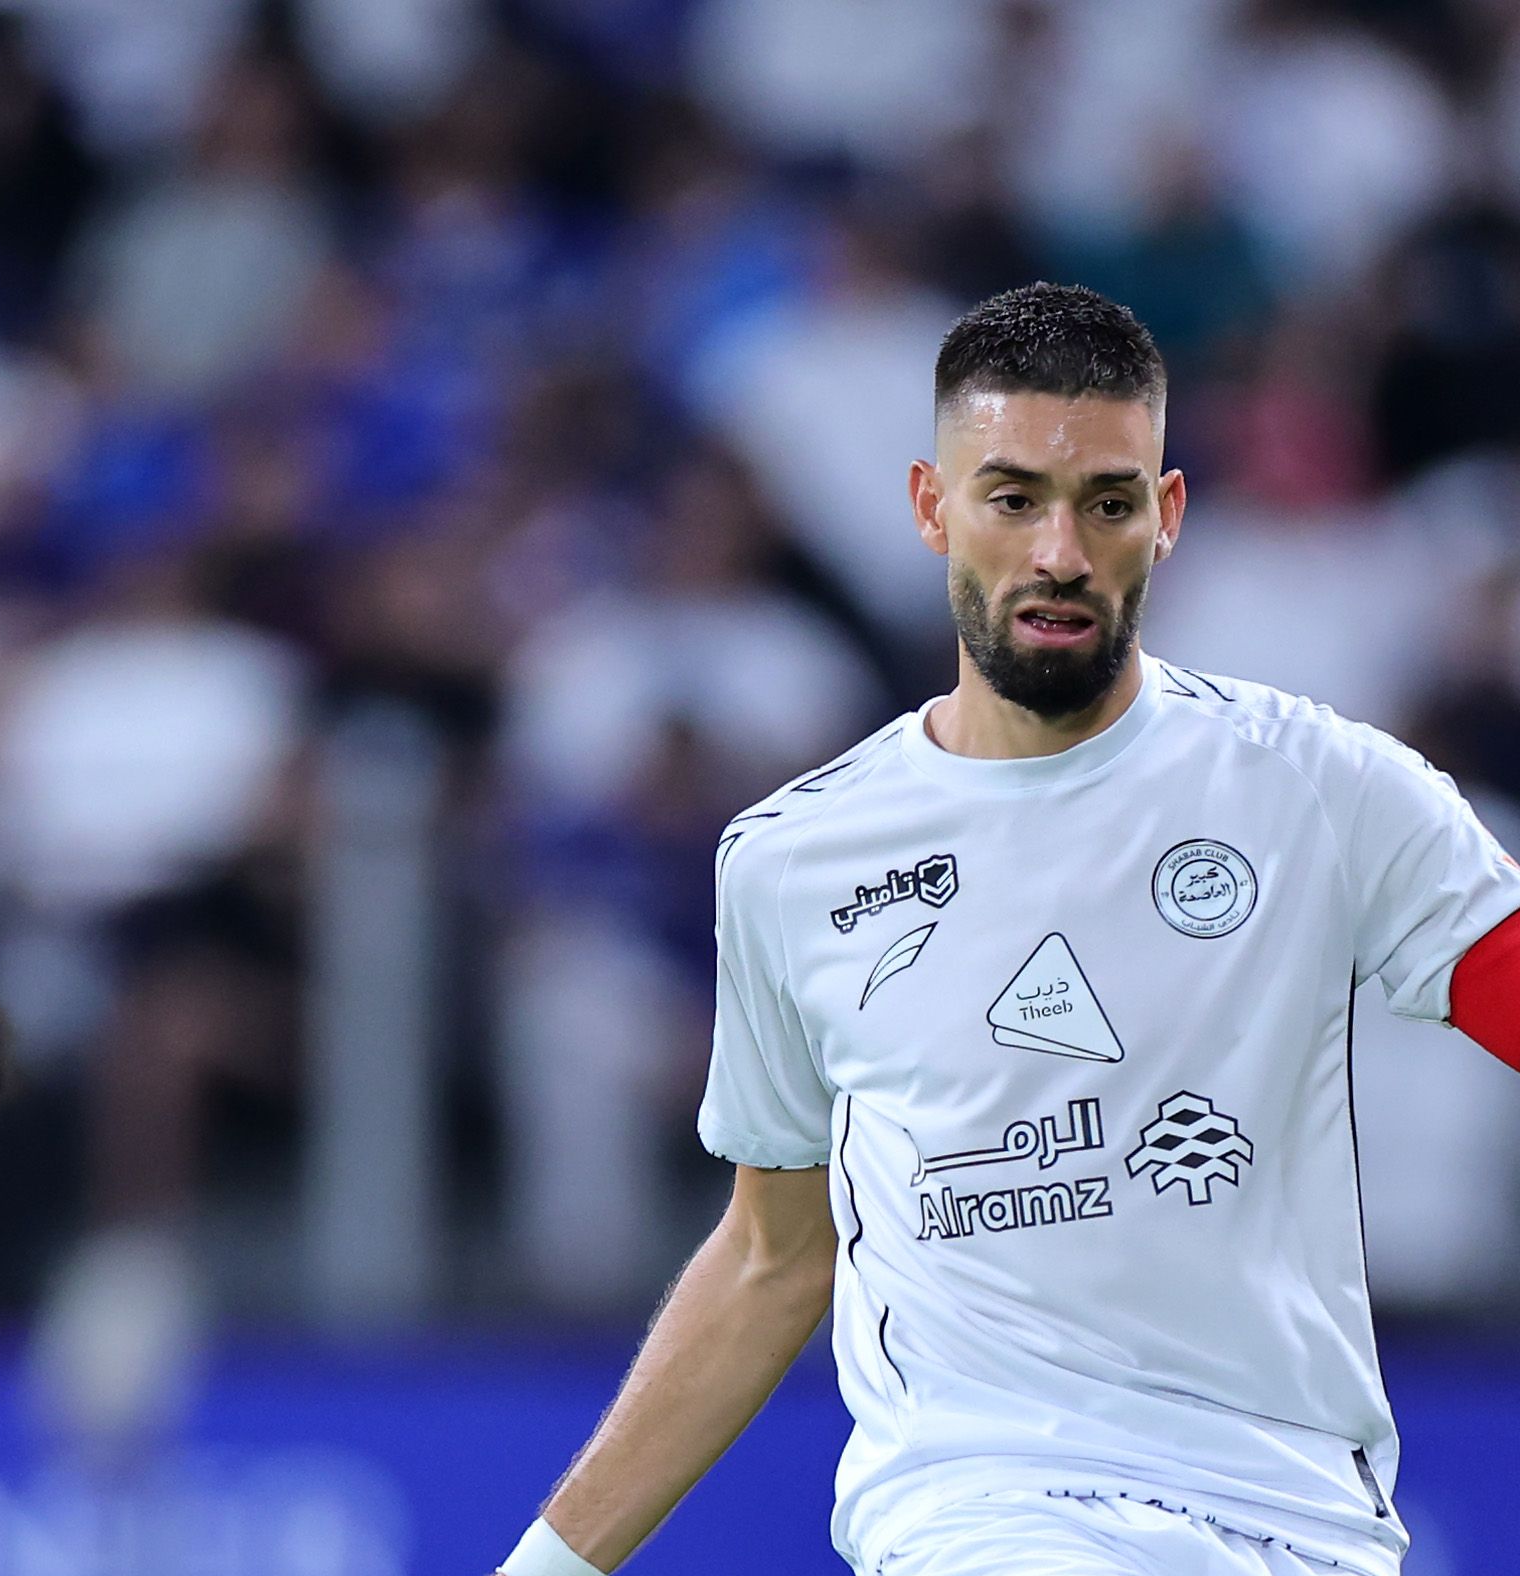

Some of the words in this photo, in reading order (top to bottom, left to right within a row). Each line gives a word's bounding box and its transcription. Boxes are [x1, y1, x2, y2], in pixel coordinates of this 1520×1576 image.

[1168, 848, 1202, 871] SHABAB
[1204, 849, 1229, 863] CLUB
[1186, 866, 1219, 888] كبير
[1019, 999, 1074, 1021] Theeb
[916, 1176, 1113, 1240] Alramz
